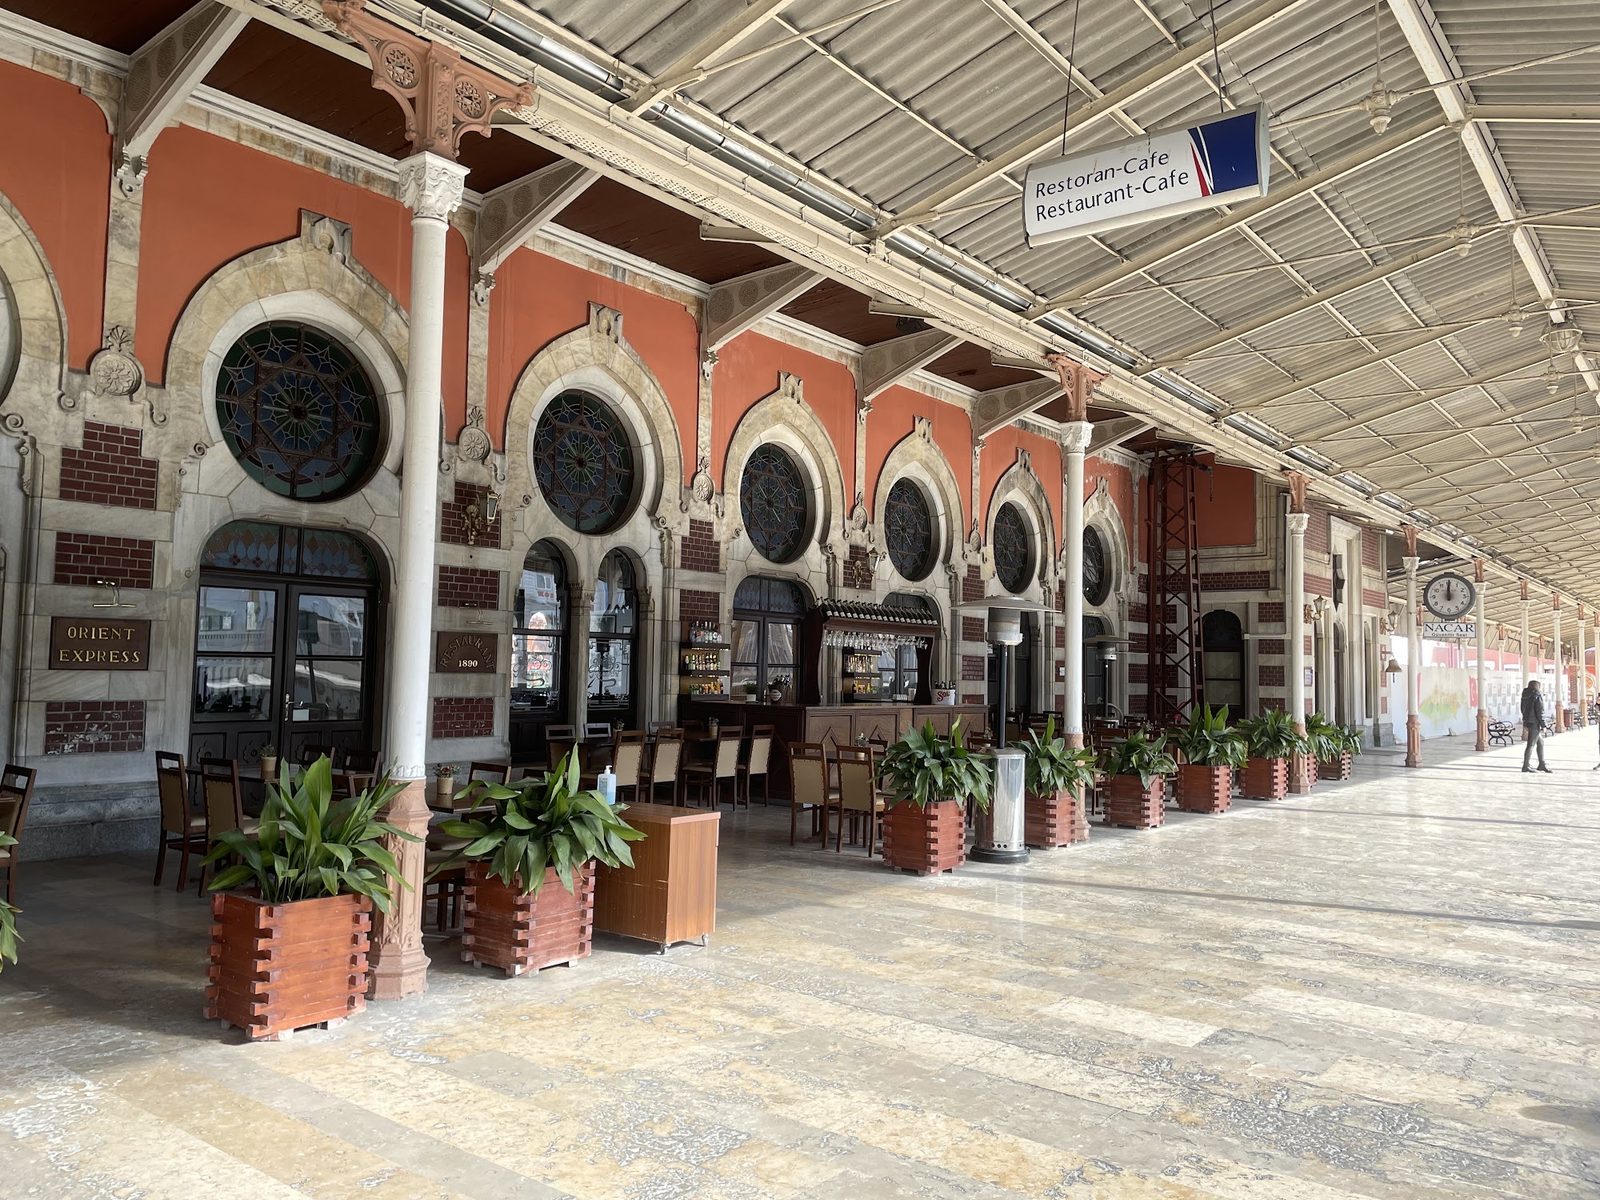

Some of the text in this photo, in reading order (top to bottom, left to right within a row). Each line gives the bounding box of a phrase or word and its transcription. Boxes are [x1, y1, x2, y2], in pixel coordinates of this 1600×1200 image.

[1035, 150, 1170, 199] Restoran-Cafe
[1036, 167, 1189, 222] Restaurant-Cafe
[67, 626, 136, 640] ORIENT
[1425, 623, 1474, 633] NACAR
[59, 649, 141, 663] EXPRESS
[458, 660, 478, 668] 1890
